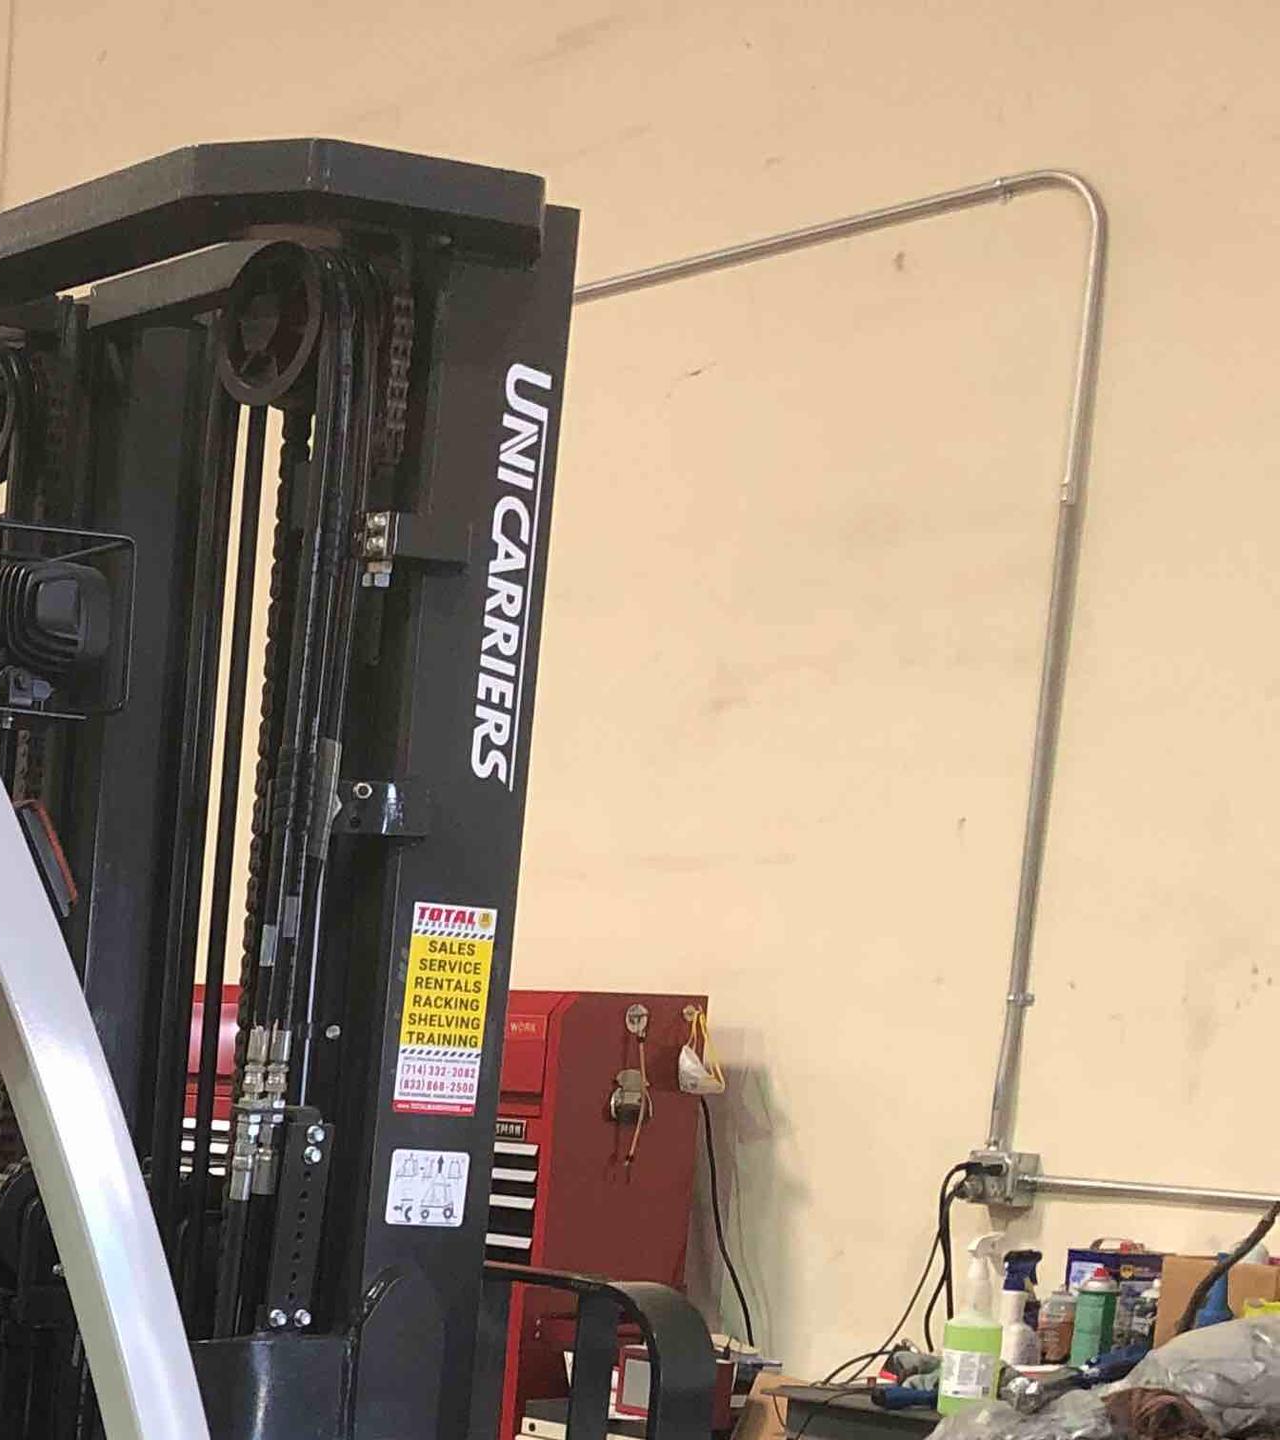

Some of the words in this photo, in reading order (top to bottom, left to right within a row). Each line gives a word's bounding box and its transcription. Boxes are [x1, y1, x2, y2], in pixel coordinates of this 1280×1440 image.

[471, 362, 553, 793] UNICARRIERS
[418, 906, 476, 925] TOTAL
[428, 940, 476, 956] SALES
[419, 958, 482, 975] SERVICE
[414, 976, 482, 994] RENTALS
[412, 994, 480, 1012] RACKING
[408, 1013, 480, 1030] SHELVING
[406, 1031, 478, 1049] TRAINING
